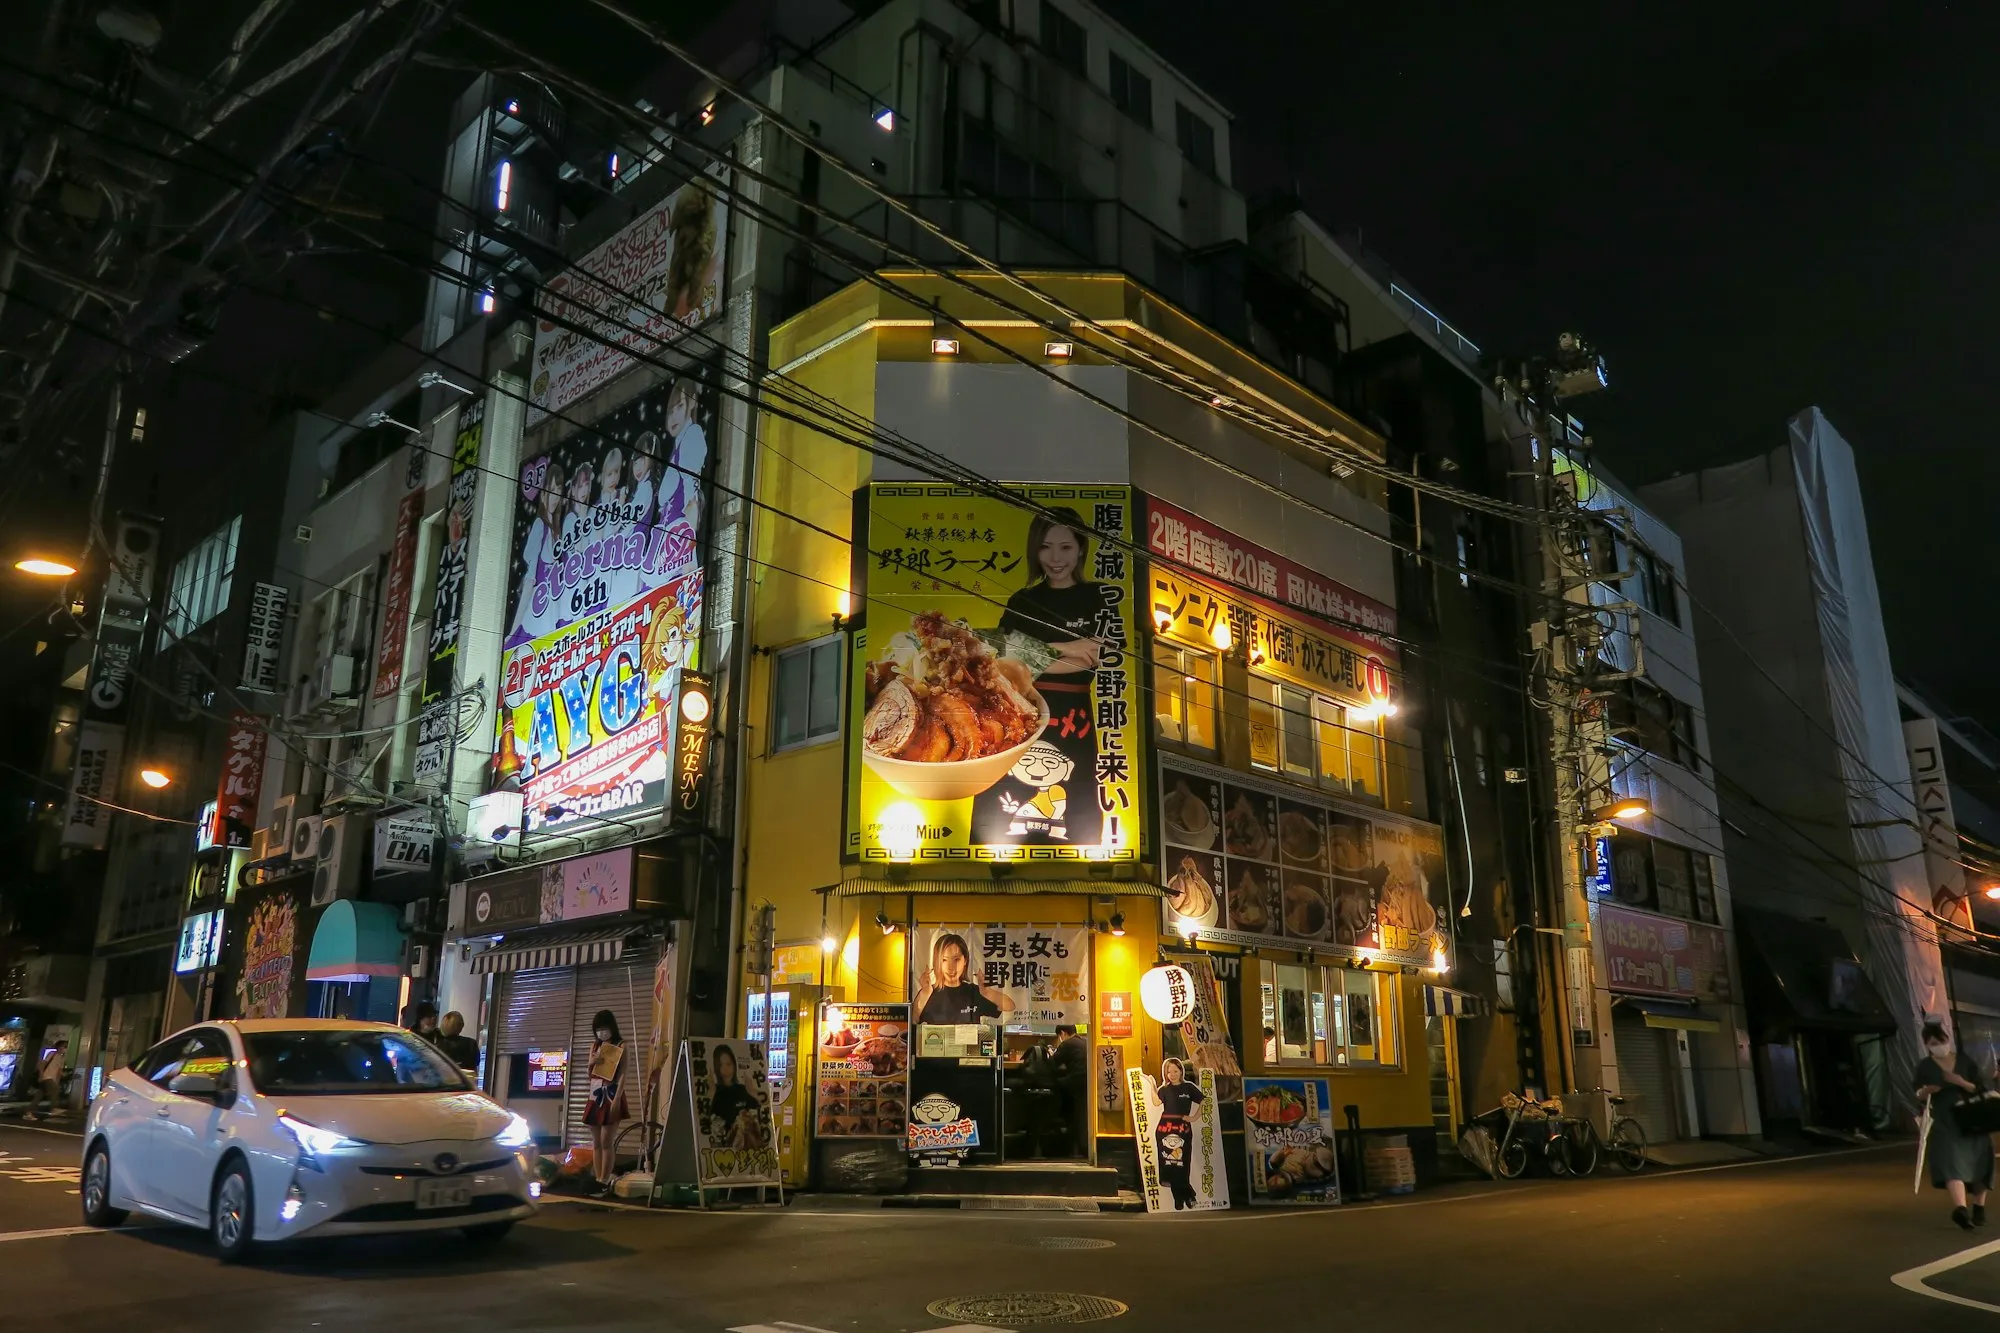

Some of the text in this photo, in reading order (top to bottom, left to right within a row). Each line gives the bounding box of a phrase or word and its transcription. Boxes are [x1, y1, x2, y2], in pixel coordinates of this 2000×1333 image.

[524, 463, 547, 492] 3F
[878, 547, 1023, 574] 野郎ラーメン
[904, 526, 997, 543] 秋葉原総本店
[1150, 511, 1278, 599] 2階座敷20席
[442, 537, 467, 644] ステーキ
[532, 526, 665, 618] eternal
[658, 553, 693, 576] eternal
[247, 585, 271, 647] BORDER
[430, 544, 452, 652] ハンバーグ
[570, 579, 609, 613] 6th
[259, 590, 287, 689] ACROSS THE
[537, 612, 613, 667] ベースボールカフェ
[505, 649, 536, 695] 2F
[520, 634, 644, 779] AYG
[225, 730, 256, 796] タケル
[681, 734, 704, 810] MENU
[229, 831, 243, 845] 1F
[386, 840, 430, 864] CIA
[916, 824, 940, 839] Miu
[983, 932, 1069, 959] 男も女も
[1041, 1010, 1057, 1020] Miu
[1165, 967, 1188, 1019] 豚野郎
[1101, 1047, 1119, 1110] 営業中
[1130, 1070, 1160, 1210] 皆様にお届けしたく精進中!!
[1254, 1126, 1327, 1147] 野郎の夏
